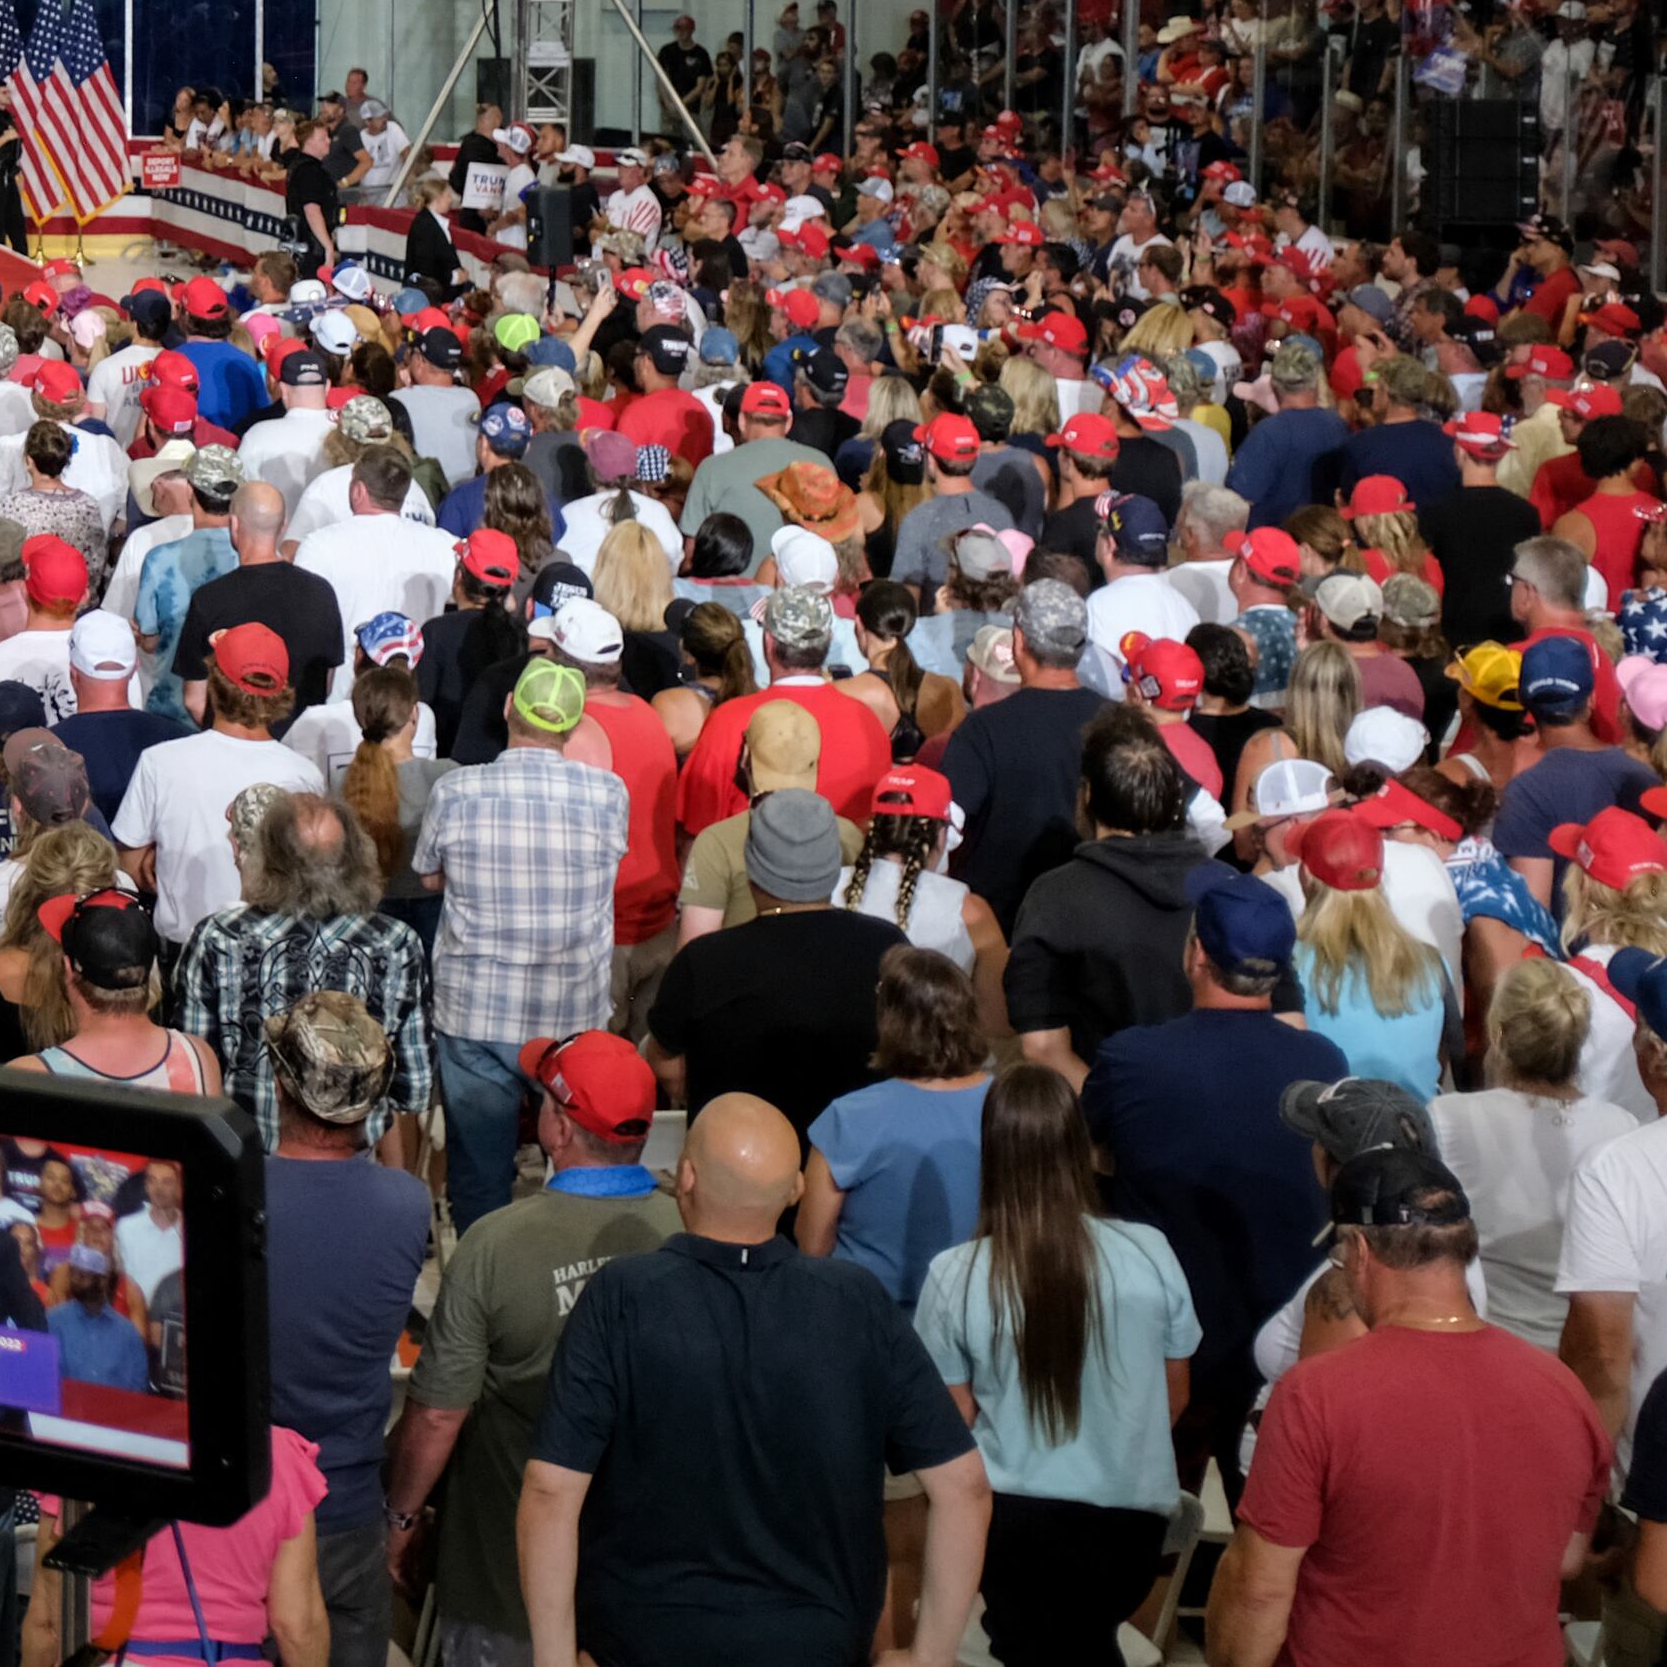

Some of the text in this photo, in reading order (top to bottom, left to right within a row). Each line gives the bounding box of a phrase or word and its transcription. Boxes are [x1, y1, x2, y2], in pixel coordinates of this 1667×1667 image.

[146, 157, 175, 165] DEPORT
[144, 164, 178, 173] ILLEGALS
[152, 173, 171, 182] NOW
